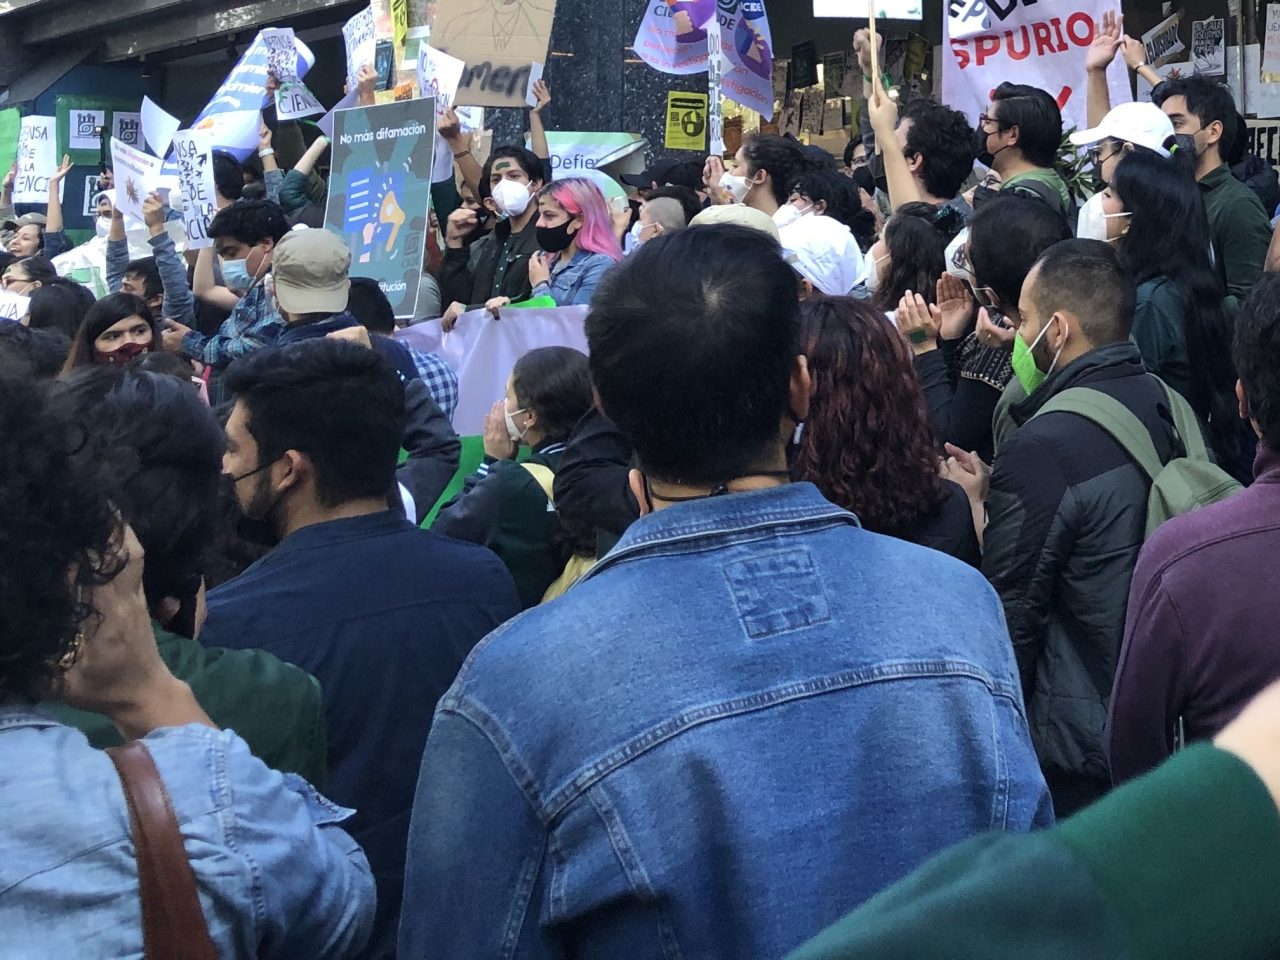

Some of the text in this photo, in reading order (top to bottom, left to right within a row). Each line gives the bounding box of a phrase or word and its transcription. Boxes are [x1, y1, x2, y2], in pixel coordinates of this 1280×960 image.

[340, 121, 426, 145] No más difamación
